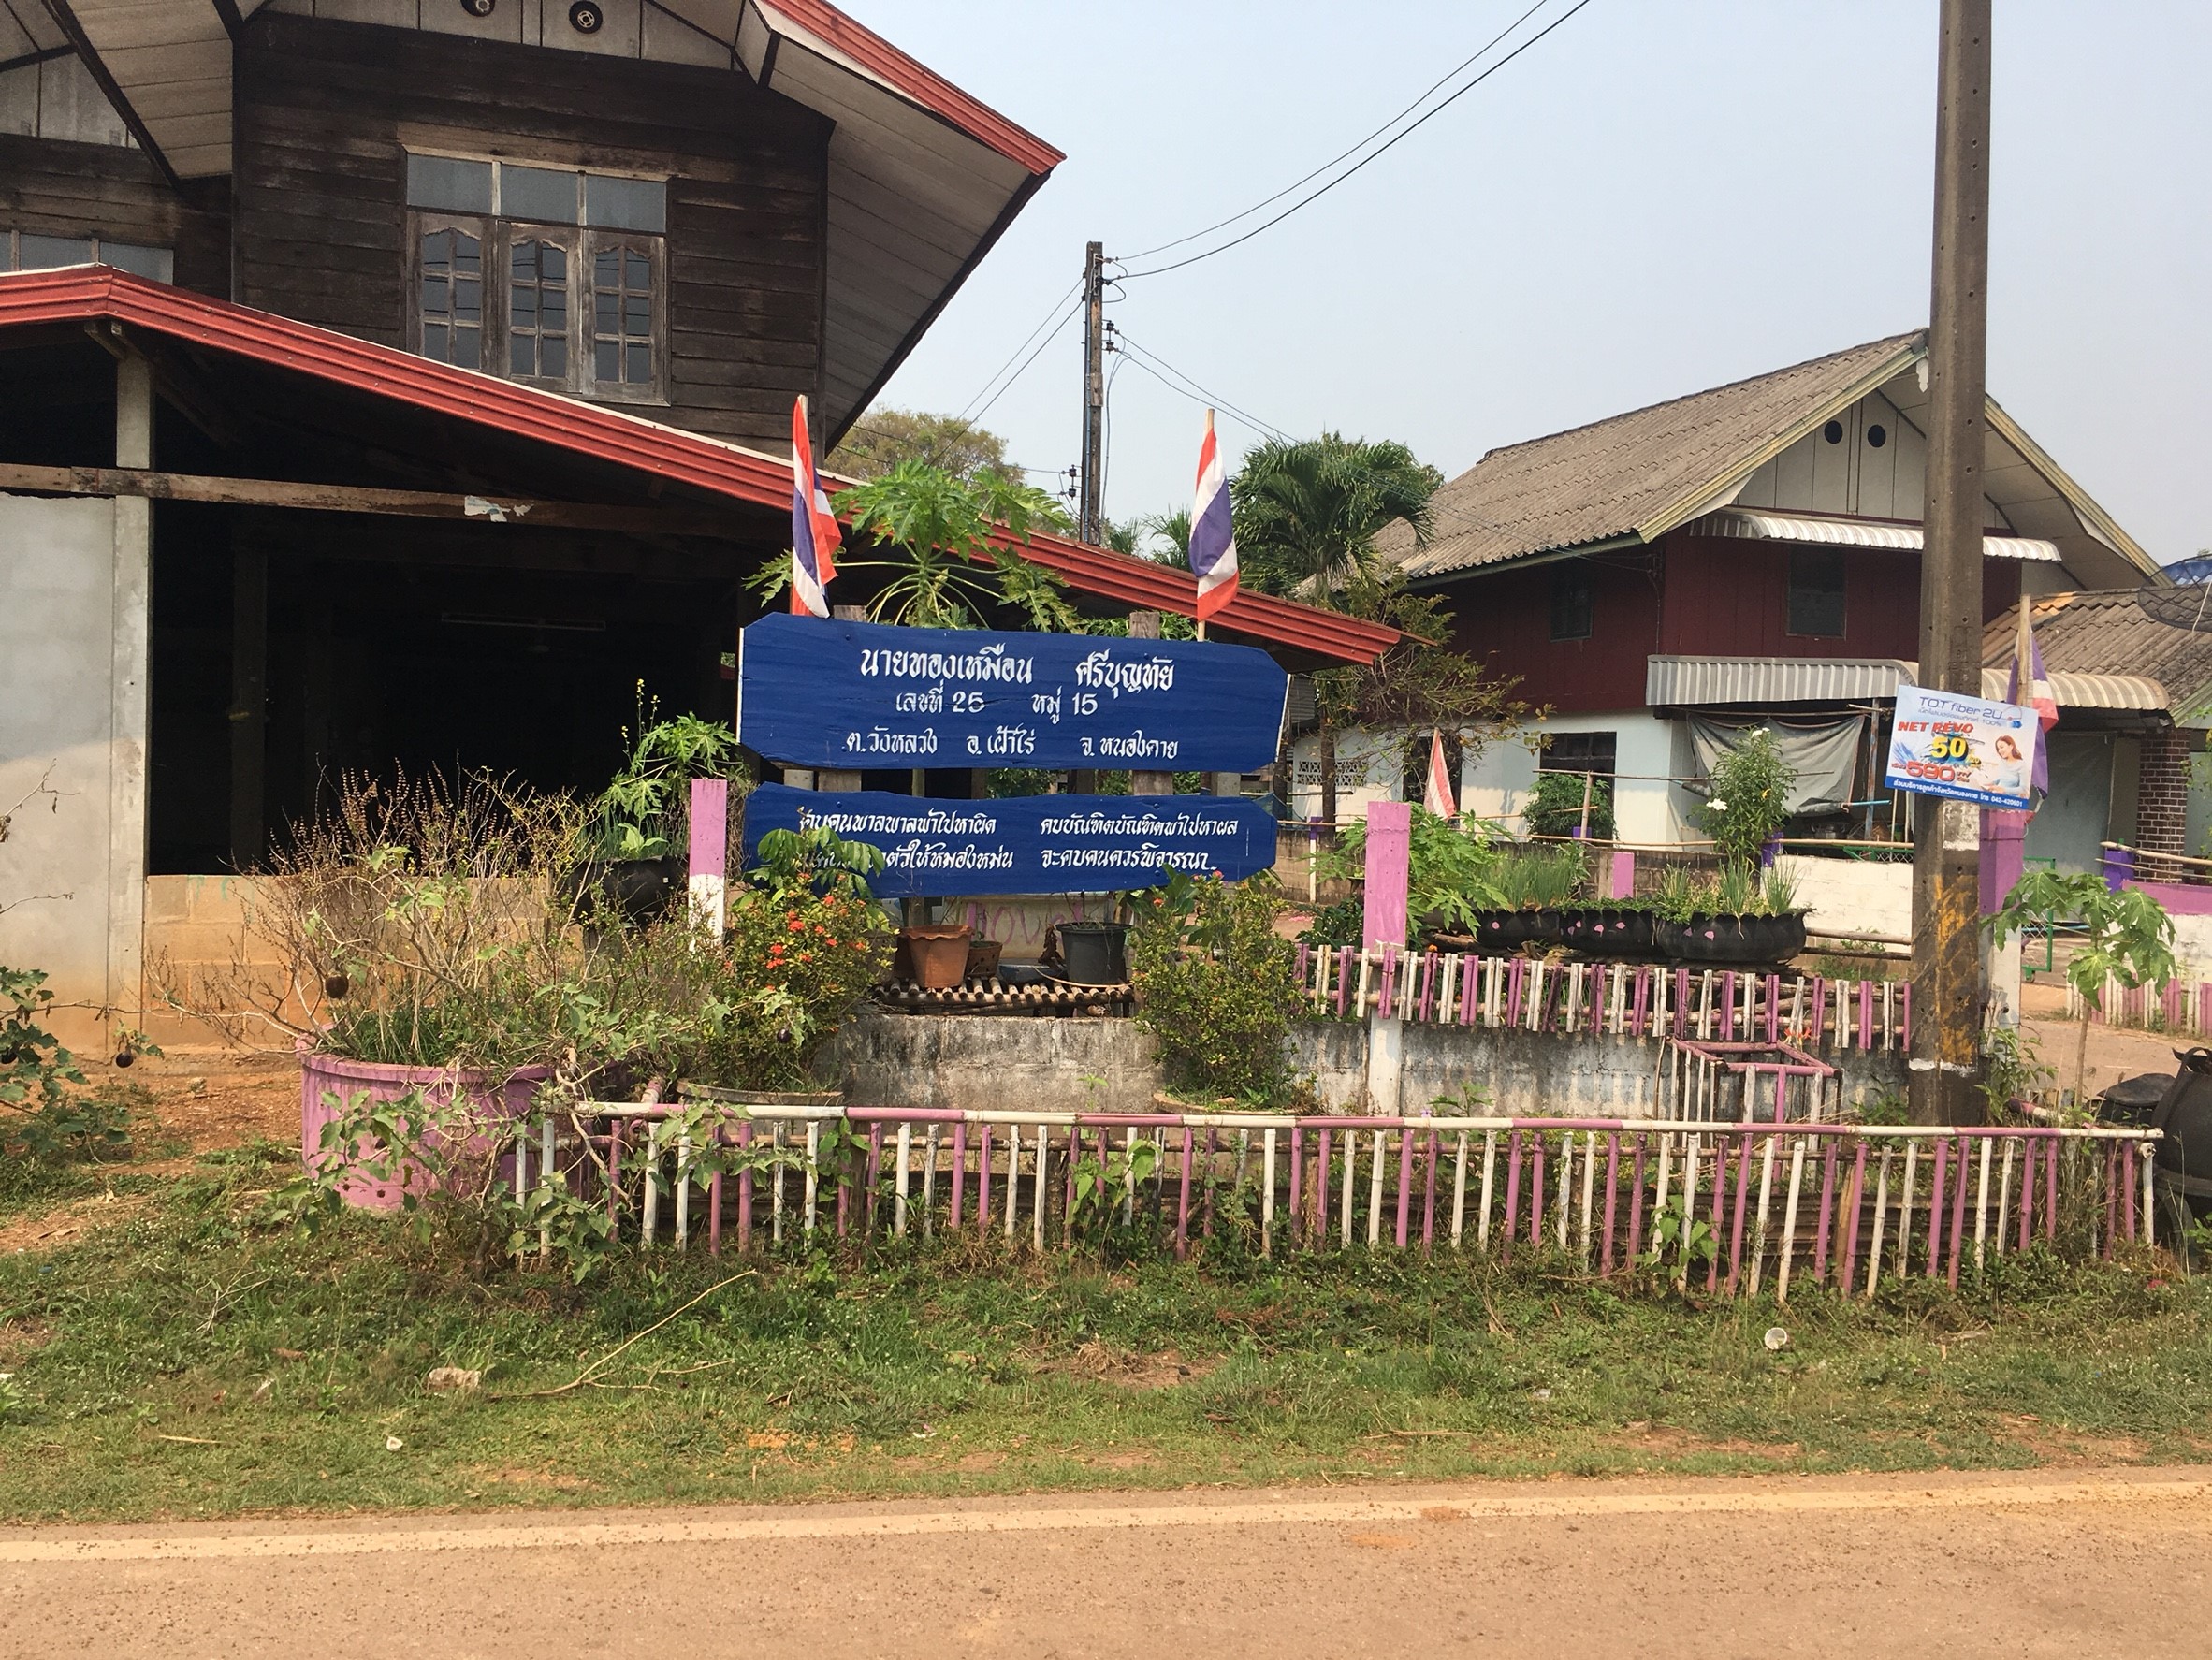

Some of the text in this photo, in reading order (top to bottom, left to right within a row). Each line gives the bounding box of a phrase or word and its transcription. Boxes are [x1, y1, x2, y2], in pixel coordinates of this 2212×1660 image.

[860, 643, 1175, 699] นายทองเหมือน ศรีบุญทัย
[896, 679, 1099, 725] เลขที่ 25 หมู่ 15
[1919, 696, 2003, 720] TOT fiber 2U
[846, 725, 939, 754] ต.วังหลวง
[1898, 721, 1974, 734] NET REVO
[1930, 735, 1968, 759] 50
[1906, 760, 1956, 782] 590
